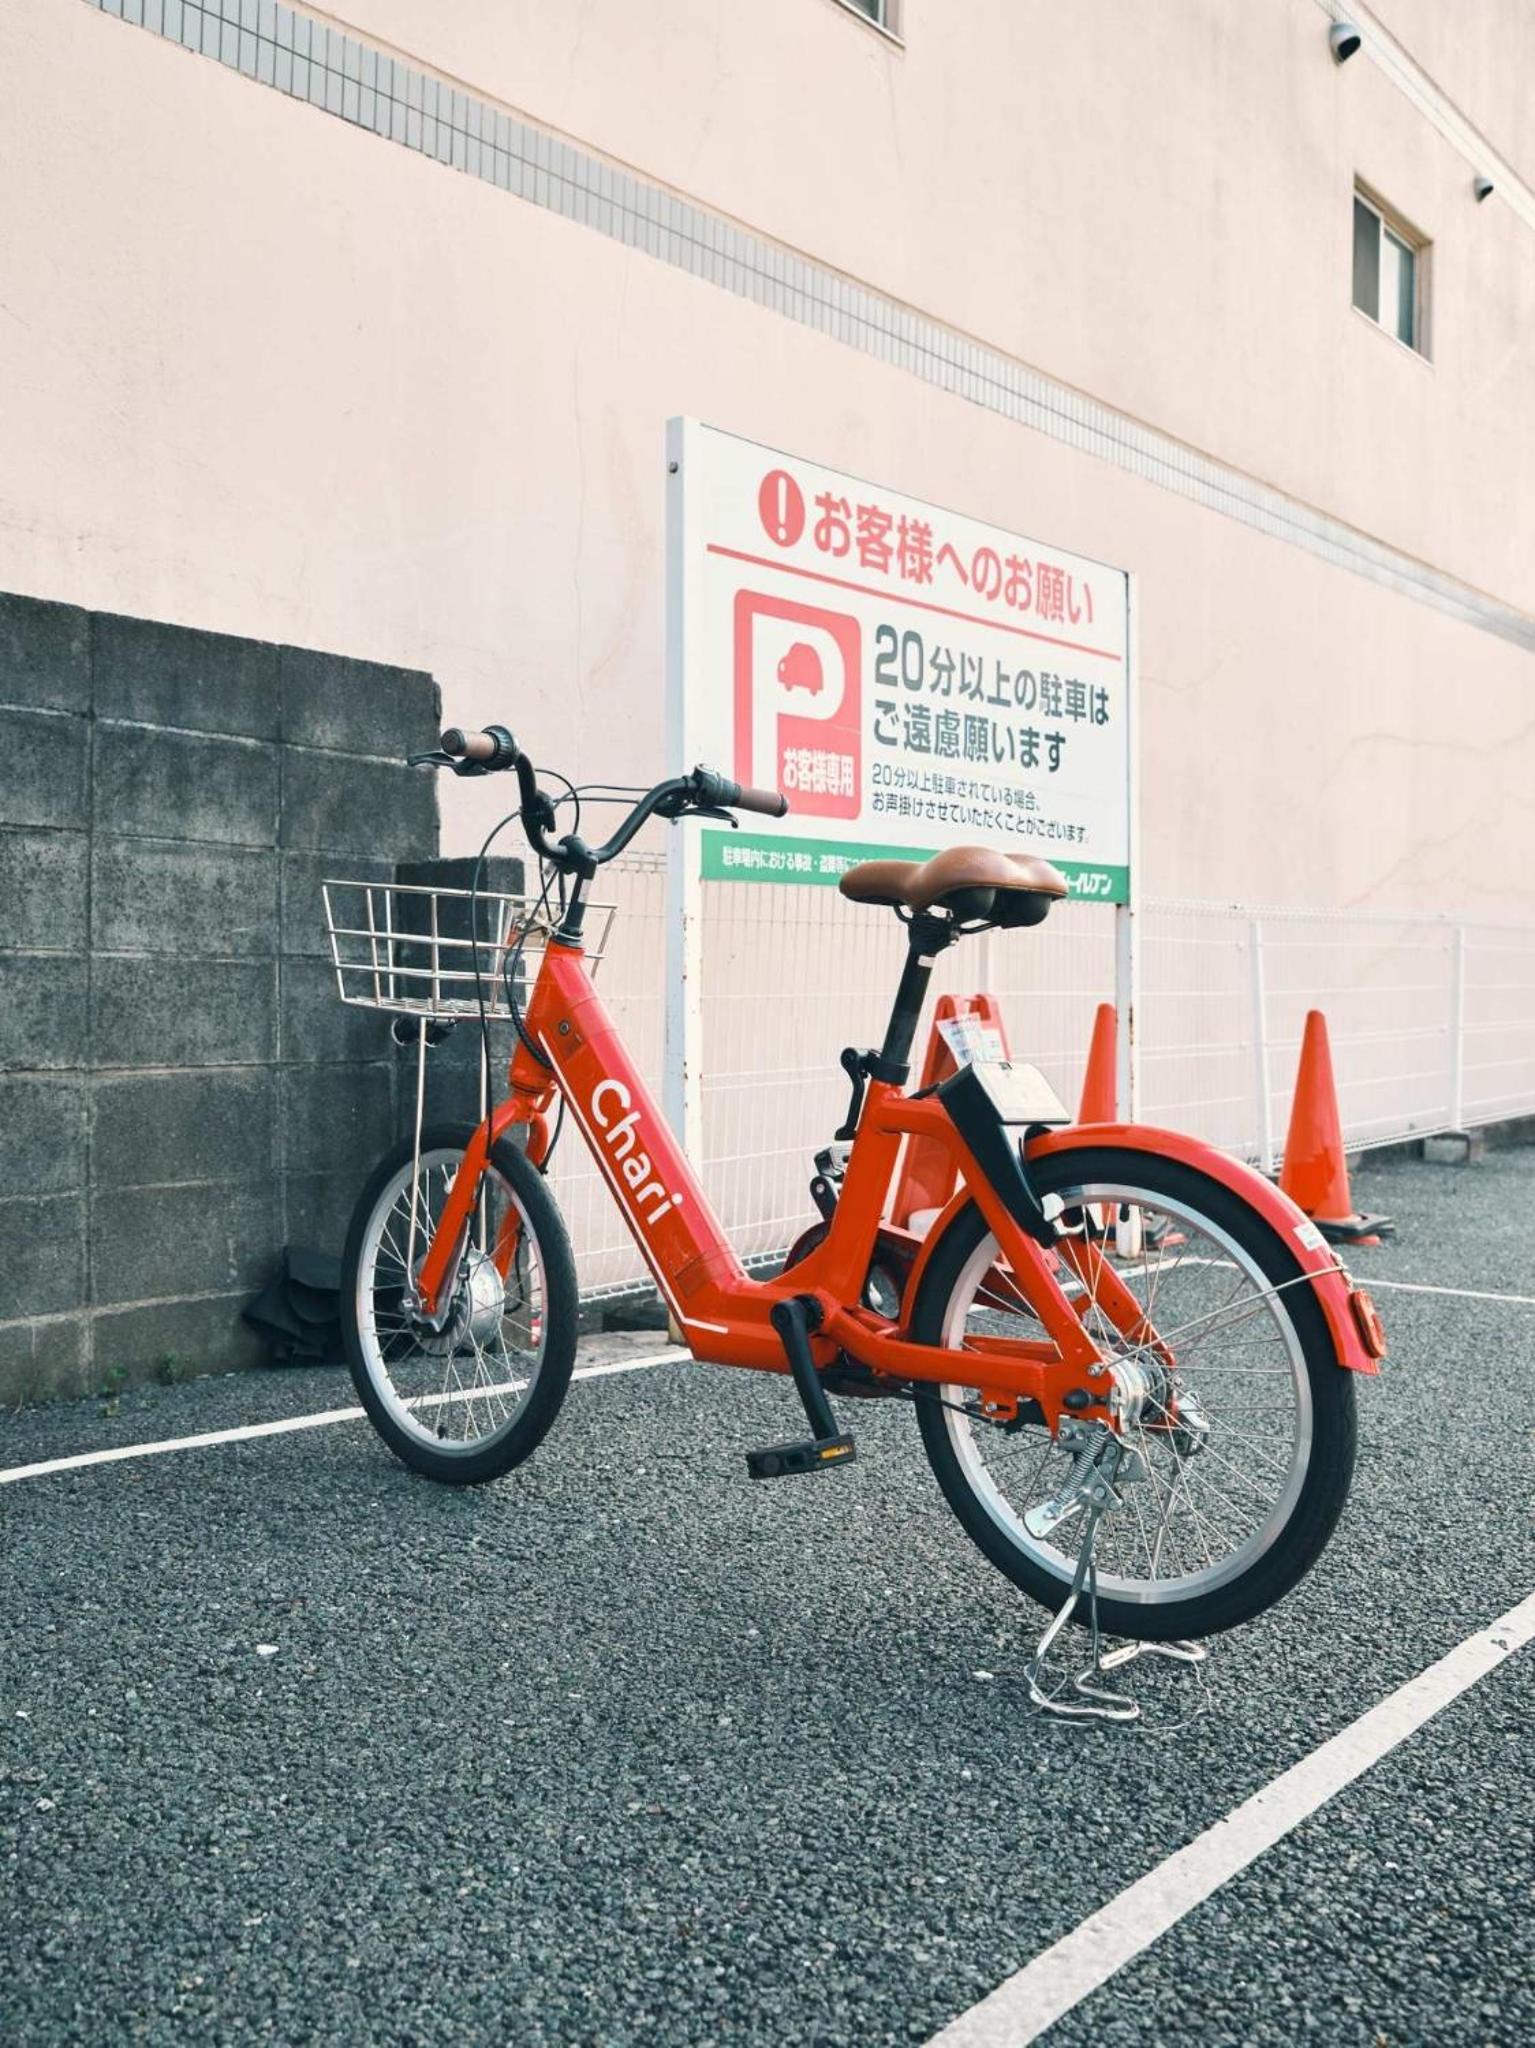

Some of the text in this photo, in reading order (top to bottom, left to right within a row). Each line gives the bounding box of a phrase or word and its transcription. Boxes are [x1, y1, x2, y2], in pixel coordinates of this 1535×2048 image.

[814, 492, 1093, 623] お客様へのお願い
[752, 612, 846, 796] P
[875, 624, 1110, 726] 20分以上の駐車は
[783, 748, 854, 797] お客様専用
[874, 699, 1066, 772] ご遠慮願います
[591, 1079, 683, 1224] Chari
